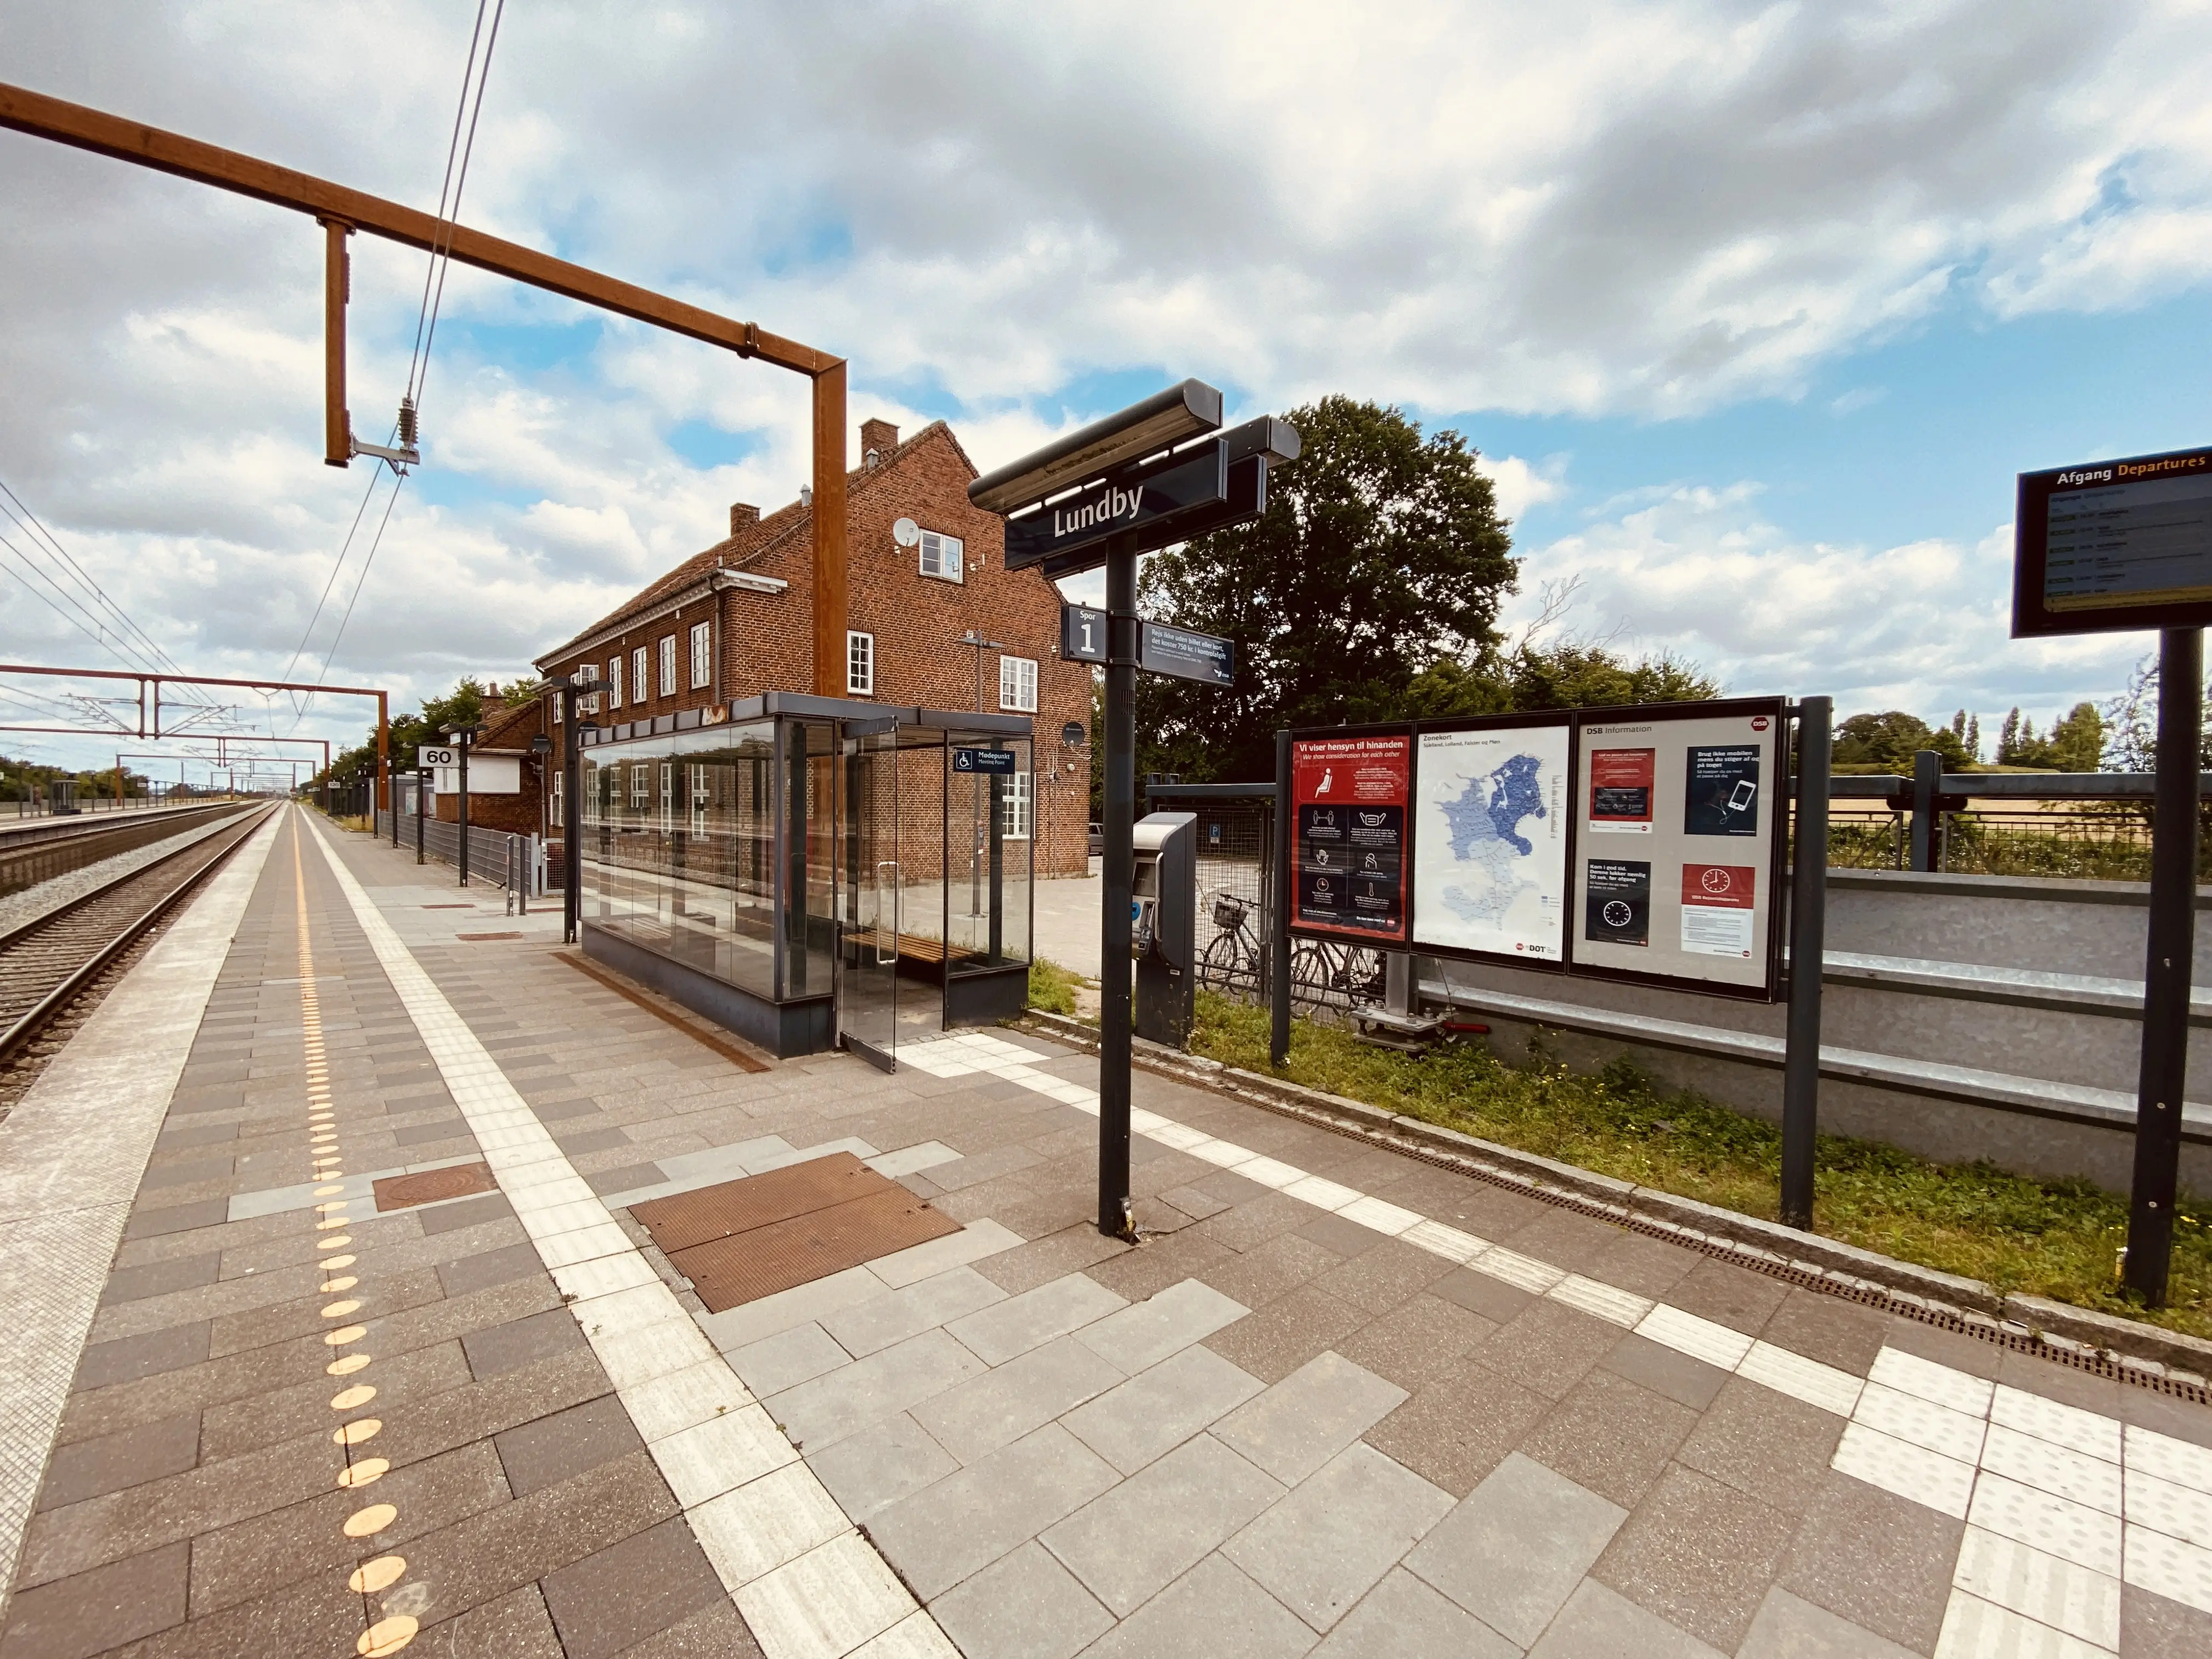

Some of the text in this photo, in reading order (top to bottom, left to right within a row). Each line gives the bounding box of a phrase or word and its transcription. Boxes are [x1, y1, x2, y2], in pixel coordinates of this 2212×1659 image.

[2057, 457, 2205, 484] Afgang Departures
[1055, 486, 1143, 537] Lundby
[1080, 610, 1096, 621] Spor
[1081, 624, 1095, 653] 1
[1152, 629, 1163, 637] Rejs
[1163, 631, 1175, 640] ikke
[1188, 637, 1201, 646] billet
[1212, 643, 1224, 652] kort,
[1152, 637, 1160, 645] det
[1161, 639, 1177, 648] koster
[1198, 648, 1226, 660] kontrolafgift
[1605, 726, 1652, 734] Information
[1328, 743, 1355, 752] hensyn
[1367, 740, 1403, 749] hinanden
[427, 751, 452, 764] 60
[978, 752, 1010, 760] Mødepunkt
[1212, 826, 1218, 835] P
